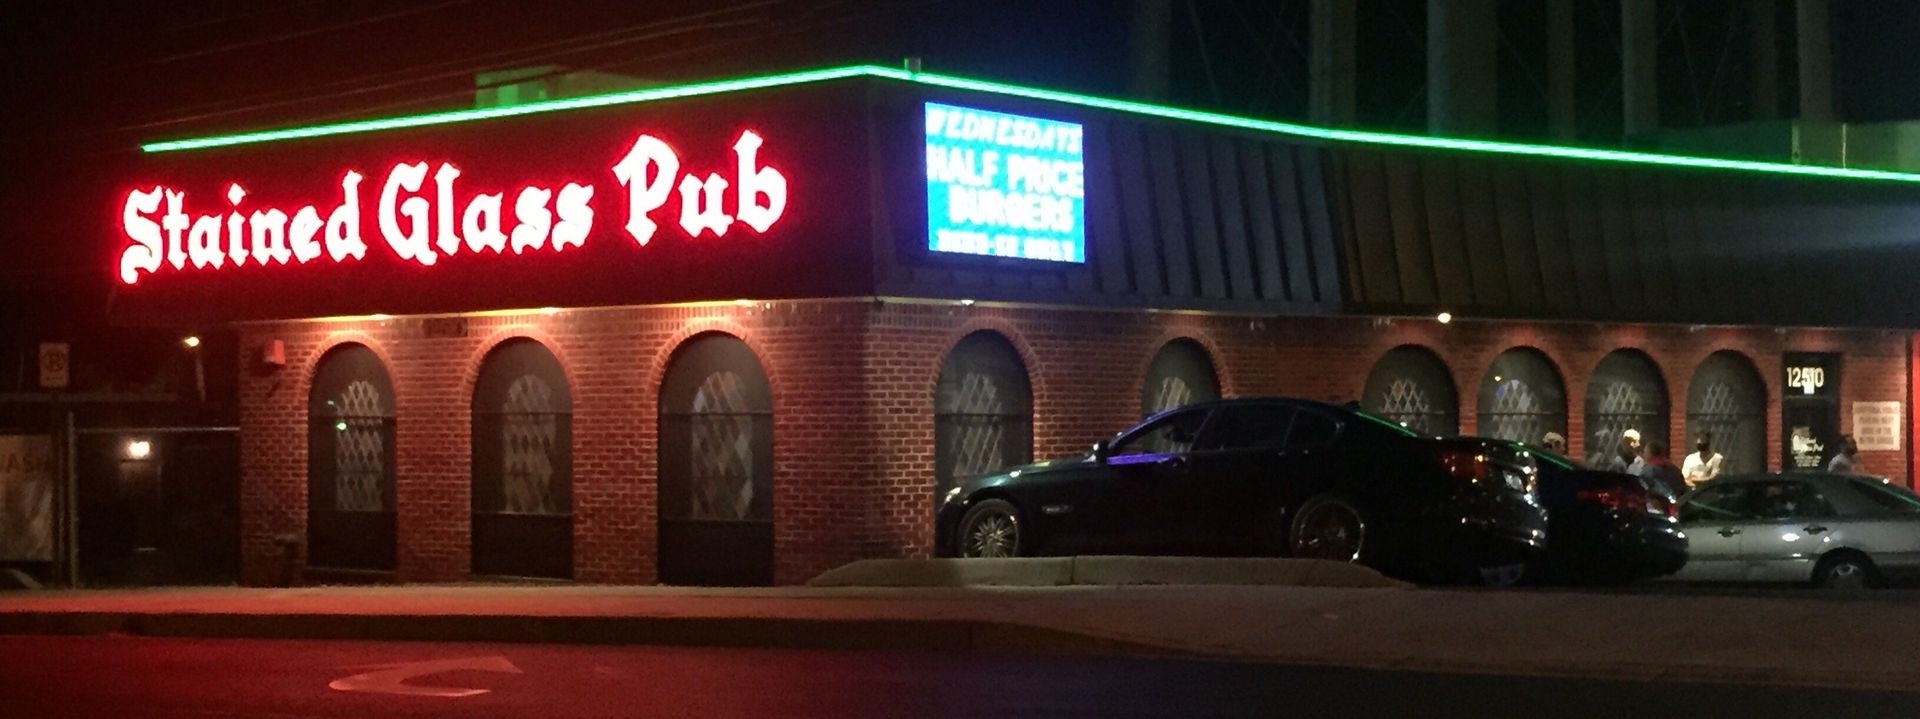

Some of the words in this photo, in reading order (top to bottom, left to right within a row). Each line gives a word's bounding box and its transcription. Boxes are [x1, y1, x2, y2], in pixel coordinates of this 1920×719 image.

[927, 107, 1083, 153] WEDNESDAYS
[926, 142, 1000, 186] HALF
[1007, 153, 1084, 197] PRICE
[121, 169, 367, 284] Stained
[379, 162, 595, 266] Glass
[613, 129, 787, 246] Pub
[949, 183, 1073, 233] BURGERS
[1786, 366, 1825, 388] 12510
